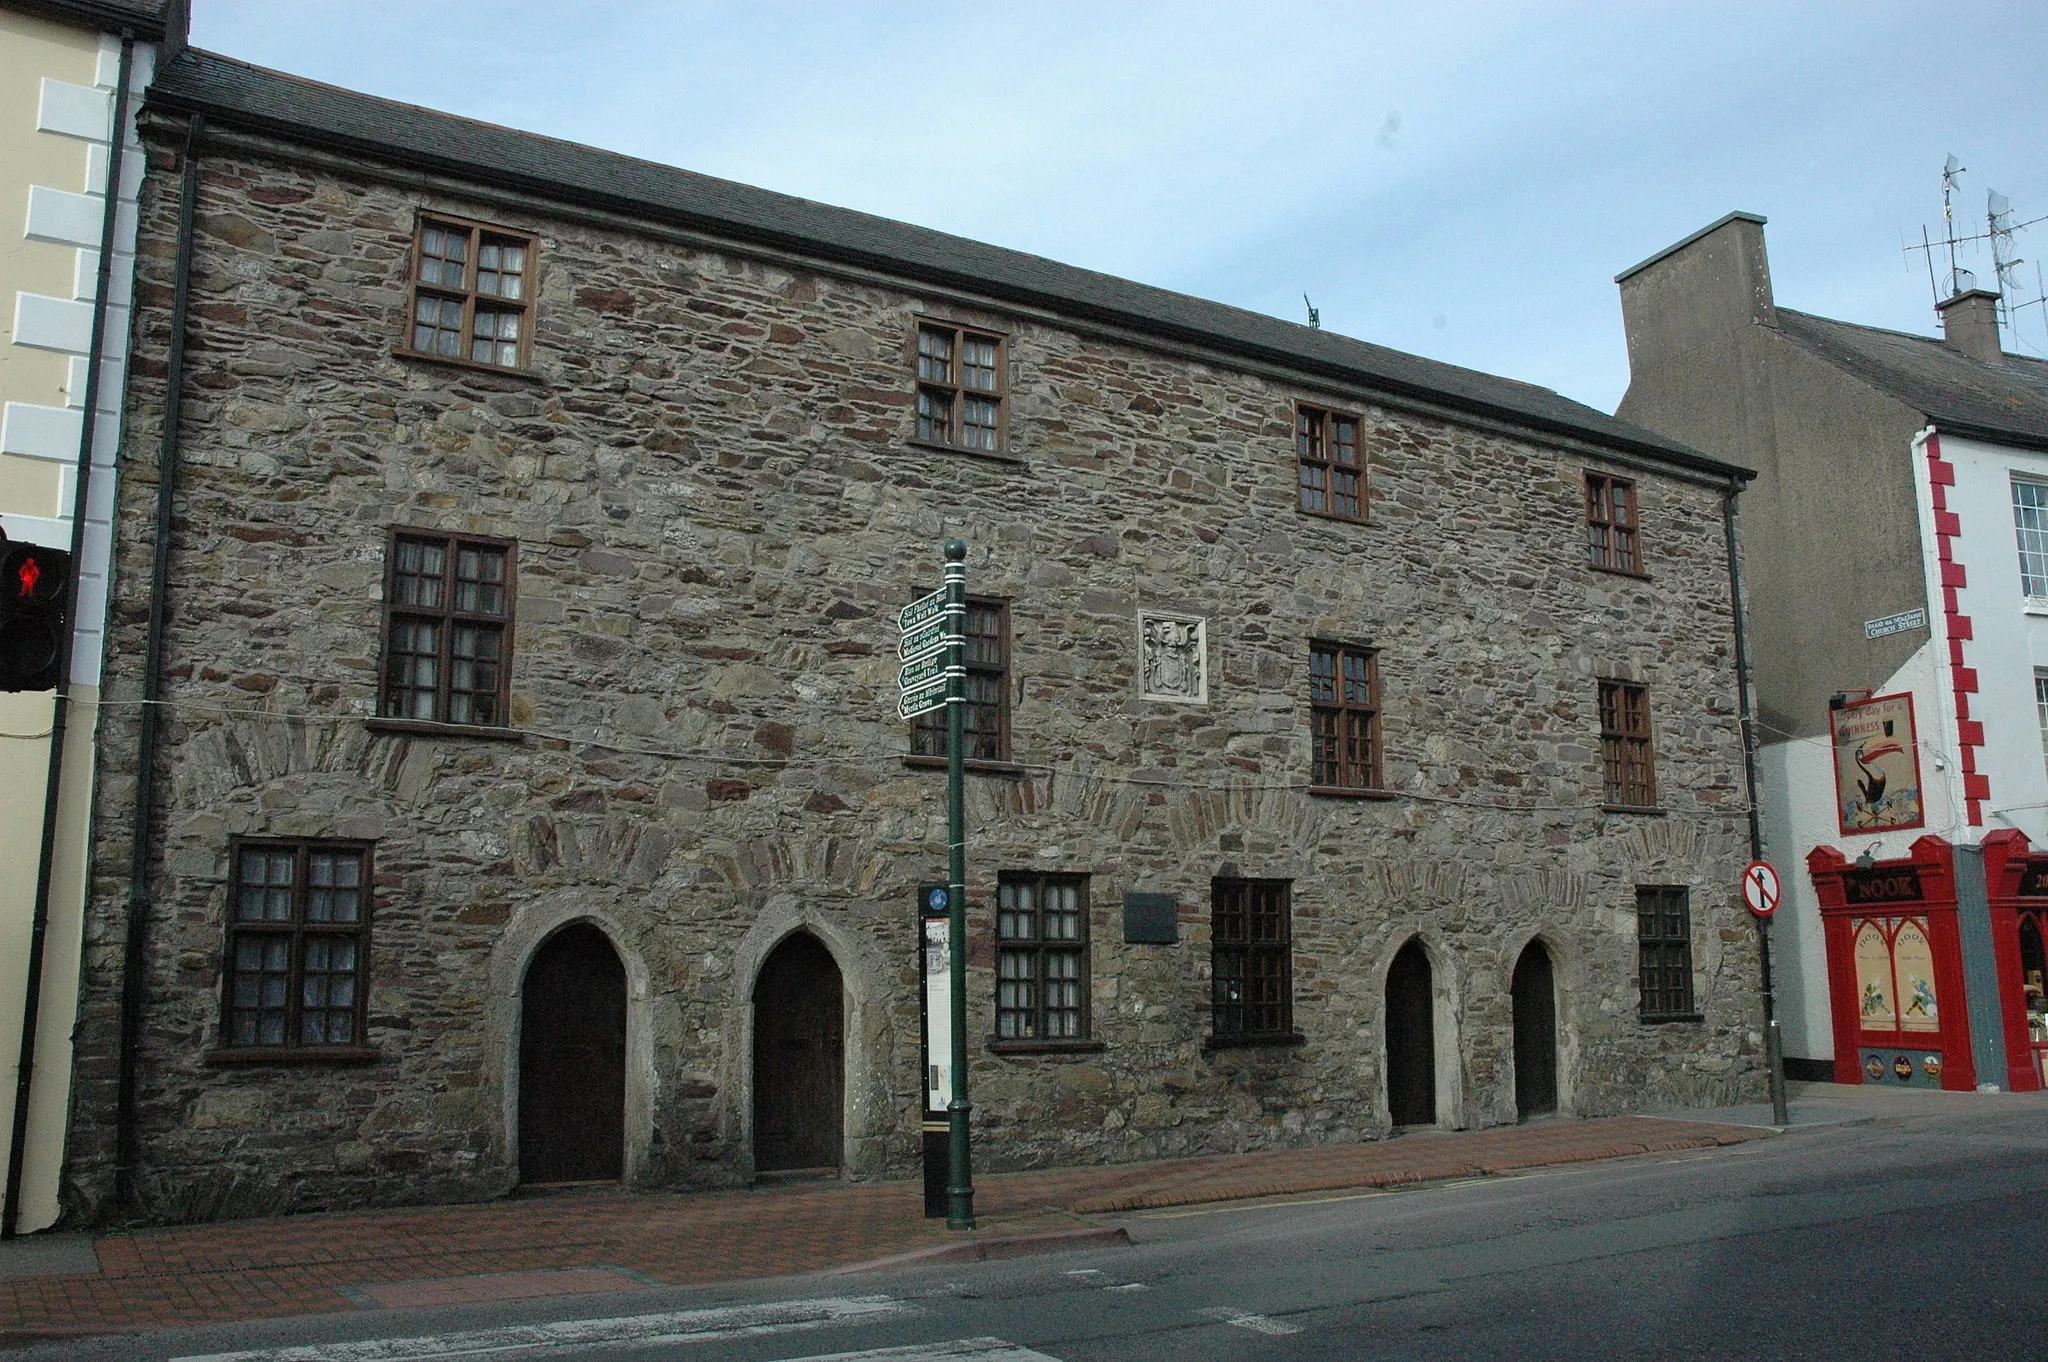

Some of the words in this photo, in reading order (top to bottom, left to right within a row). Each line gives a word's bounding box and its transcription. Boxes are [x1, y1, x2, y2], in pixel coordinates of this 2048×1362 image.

[904, 617, 916, 628] Town
[916, 610, 927, 622] Wall
[927, 604, 939, 616] Walk
[1871, 625, 1896, 636] CHURCH
[1898, 619, 1921, 630] STREET
[922, 635, 939, 649] Gardens
[904, 668, 927, 686] Graveyard
[927, 664, 938, 677] Trail
[904, 702, 919, 715] Myrtle
[919, 699, 933, 709] Grove
[1865, 706, 1880, 718] day
[1883, 702, 1895, 713] for
[1840, 720, 1880, 737] GUINNESS
[1860, 877, 1916, 898] NOOK
